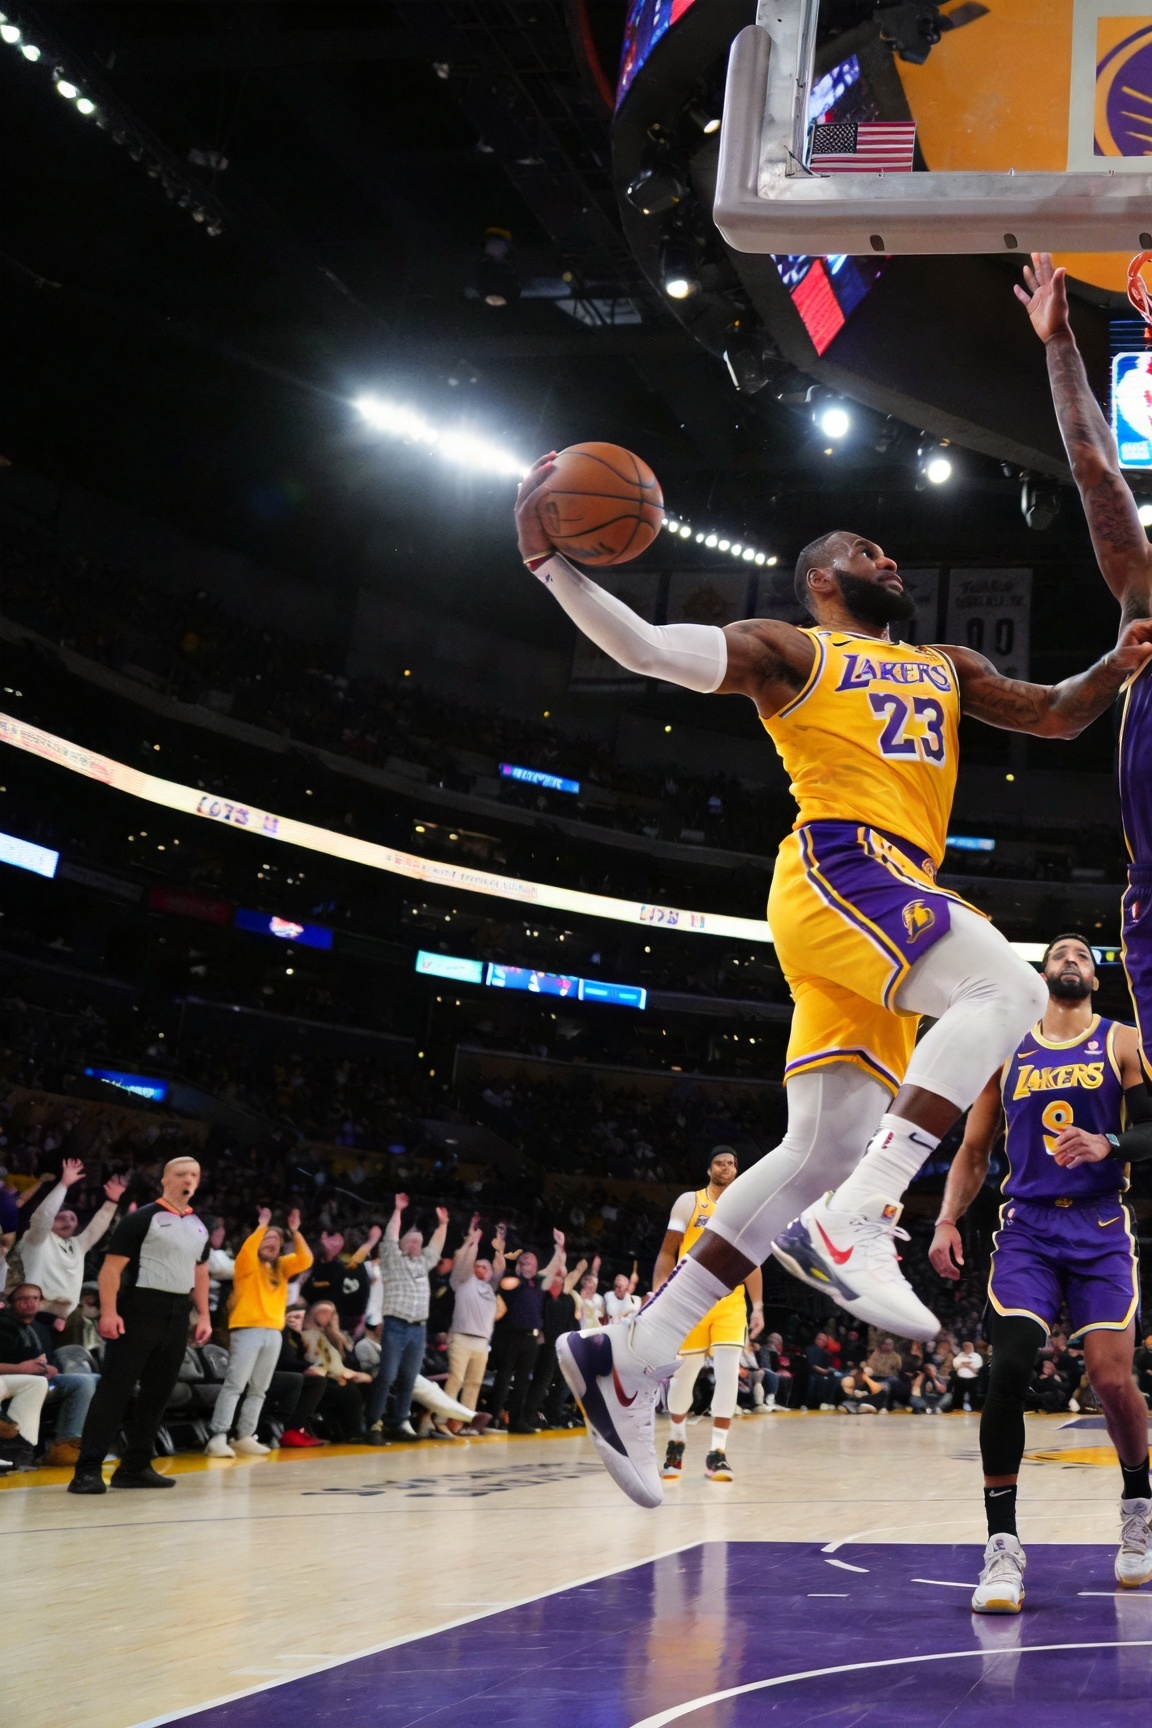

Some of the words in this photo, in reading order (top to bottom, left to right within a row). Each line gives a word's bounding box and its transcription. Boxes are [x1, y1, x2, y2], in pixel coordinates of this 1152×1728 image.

[834, 653, 951, 692] LAKERS
[867, 692, 947, 769] 23
[1012, 1061, 1104, 1101] LAKERS
